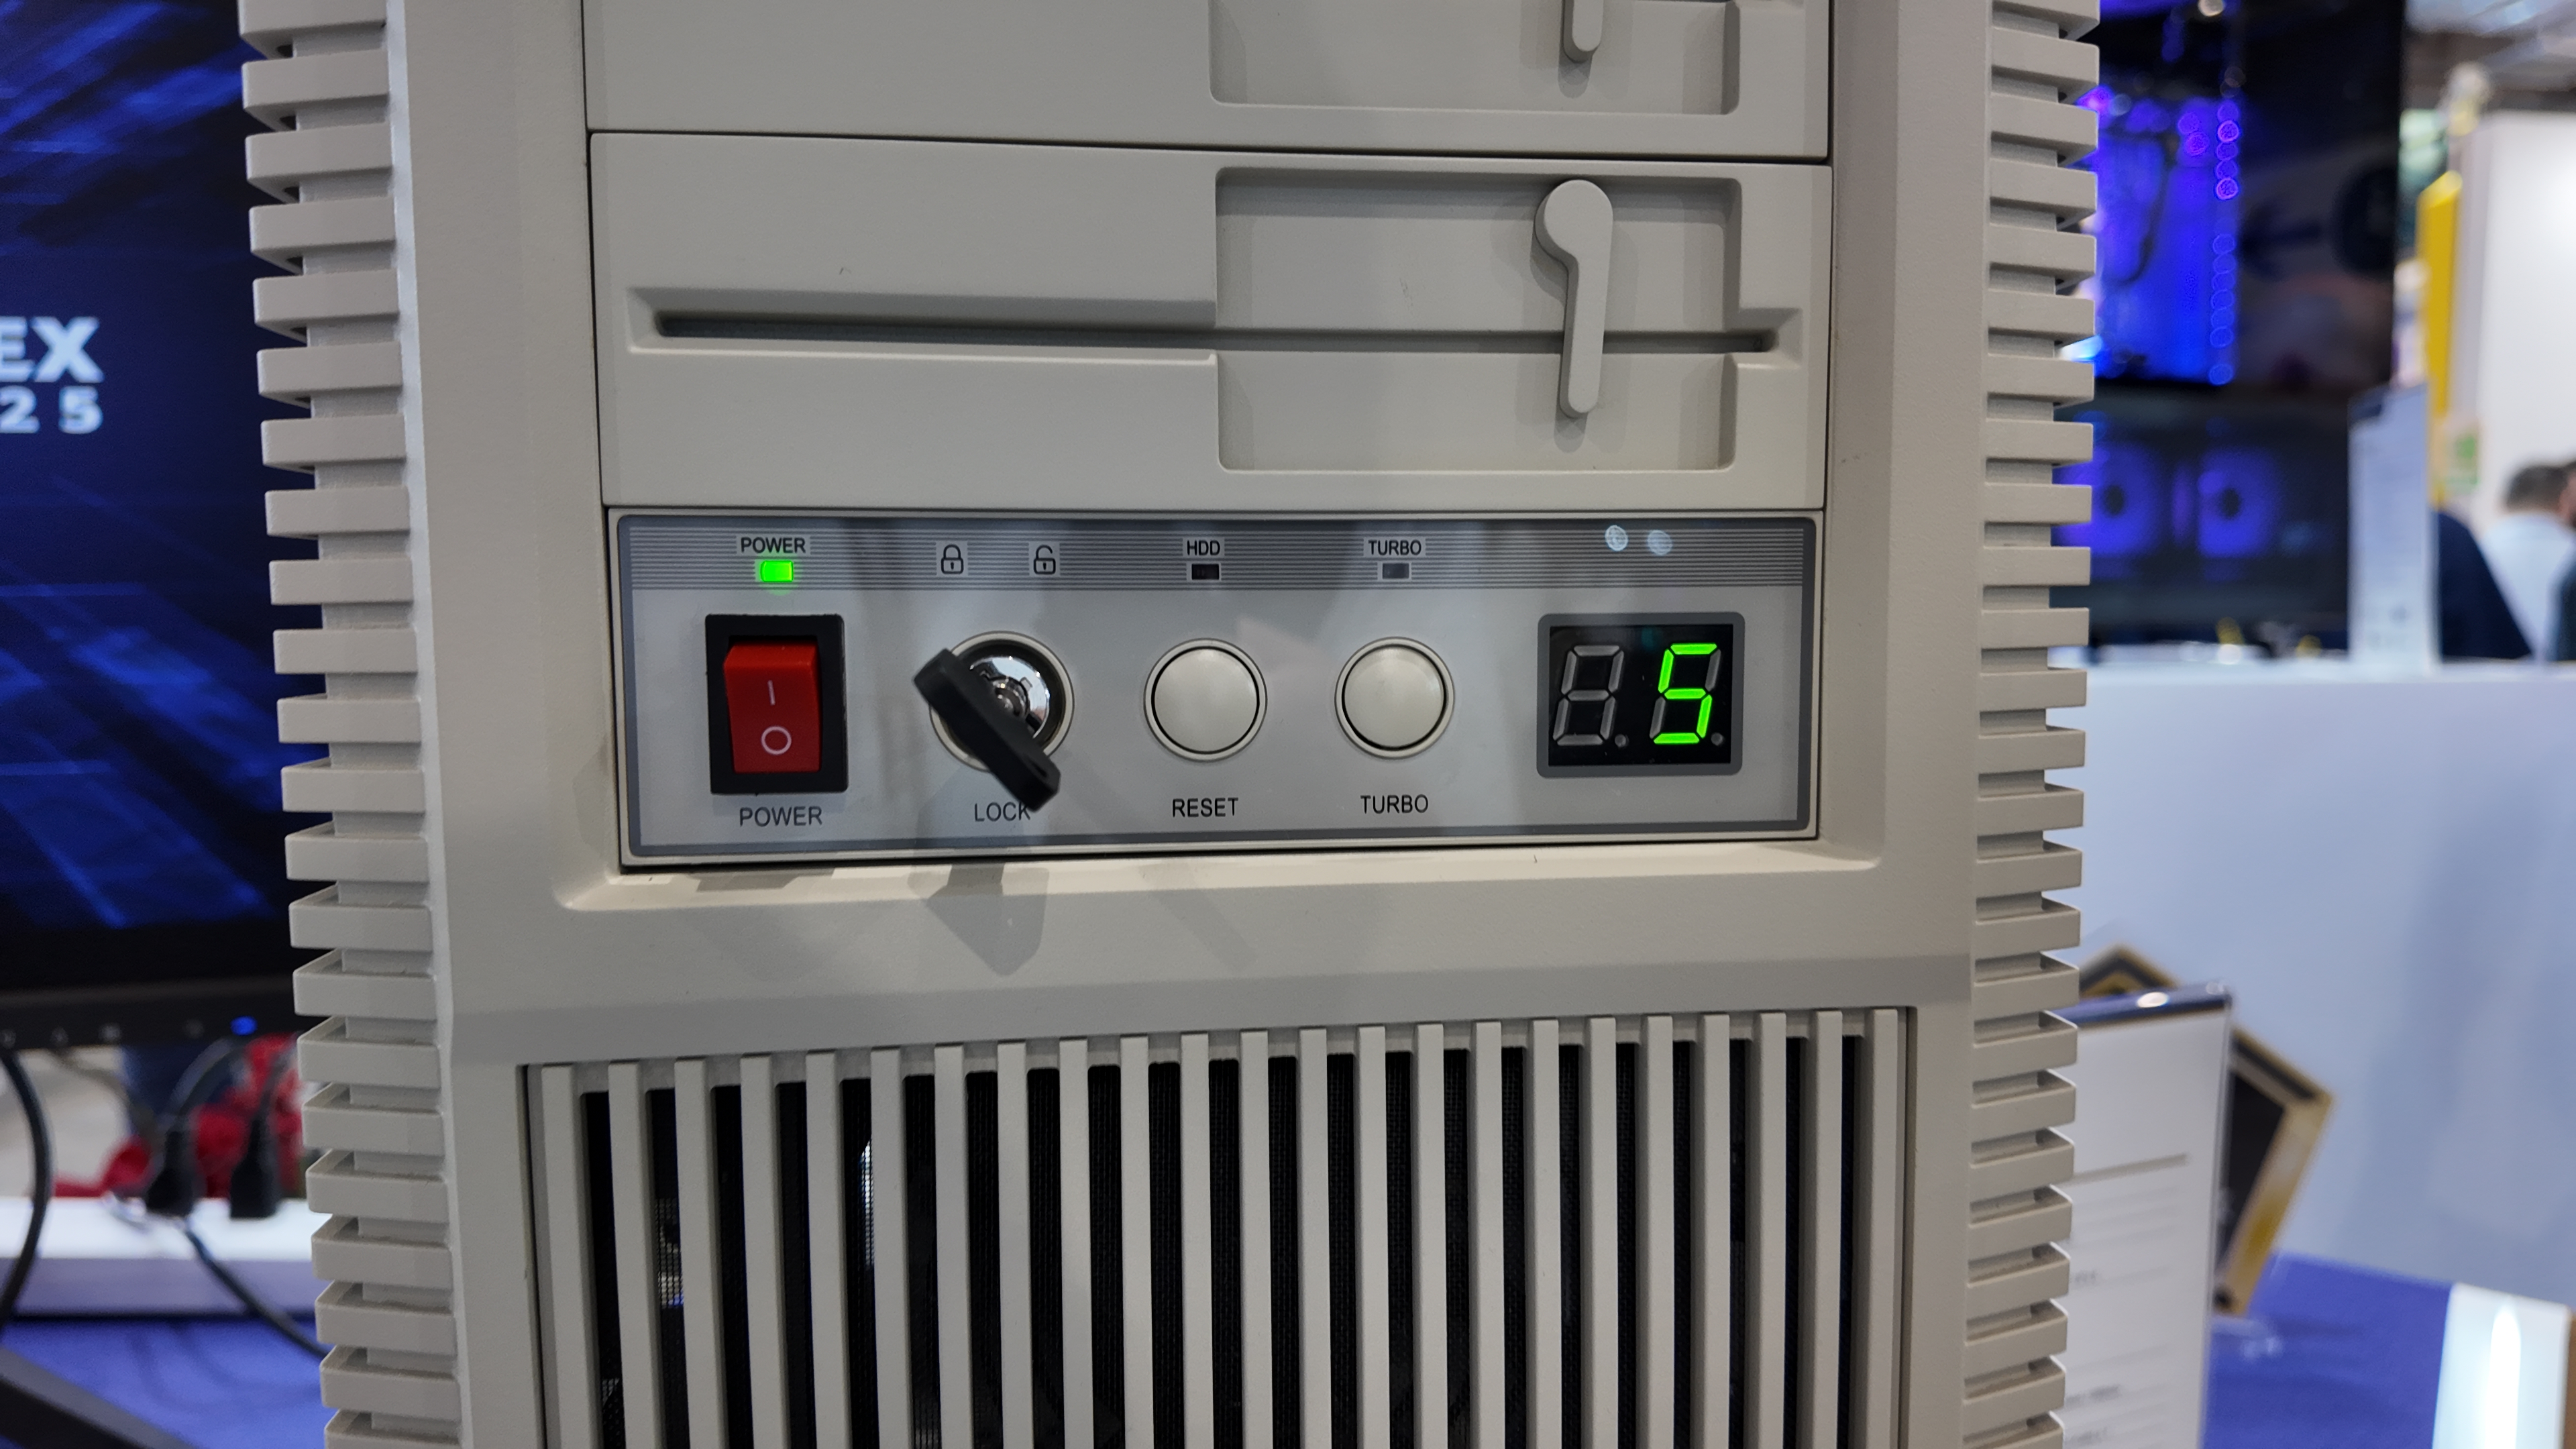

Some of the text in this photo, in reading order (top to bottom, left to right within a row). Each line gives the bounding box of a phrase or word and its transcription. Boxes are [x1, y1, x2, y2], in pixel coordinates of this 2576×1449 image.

[741, 537, 806, 553] POWER
[1187, 539, 1220, 555] HDD
[1368, 539, 1421, 555] TURBO
[1653, 642, 1718, 745] 5
[974, 801, 1031, 822] LOCK
[1172, 797, 1239, 817] RESET
[1360, 794, 1429, 814] TURBO
[739, 806, 822, 827] POWER
